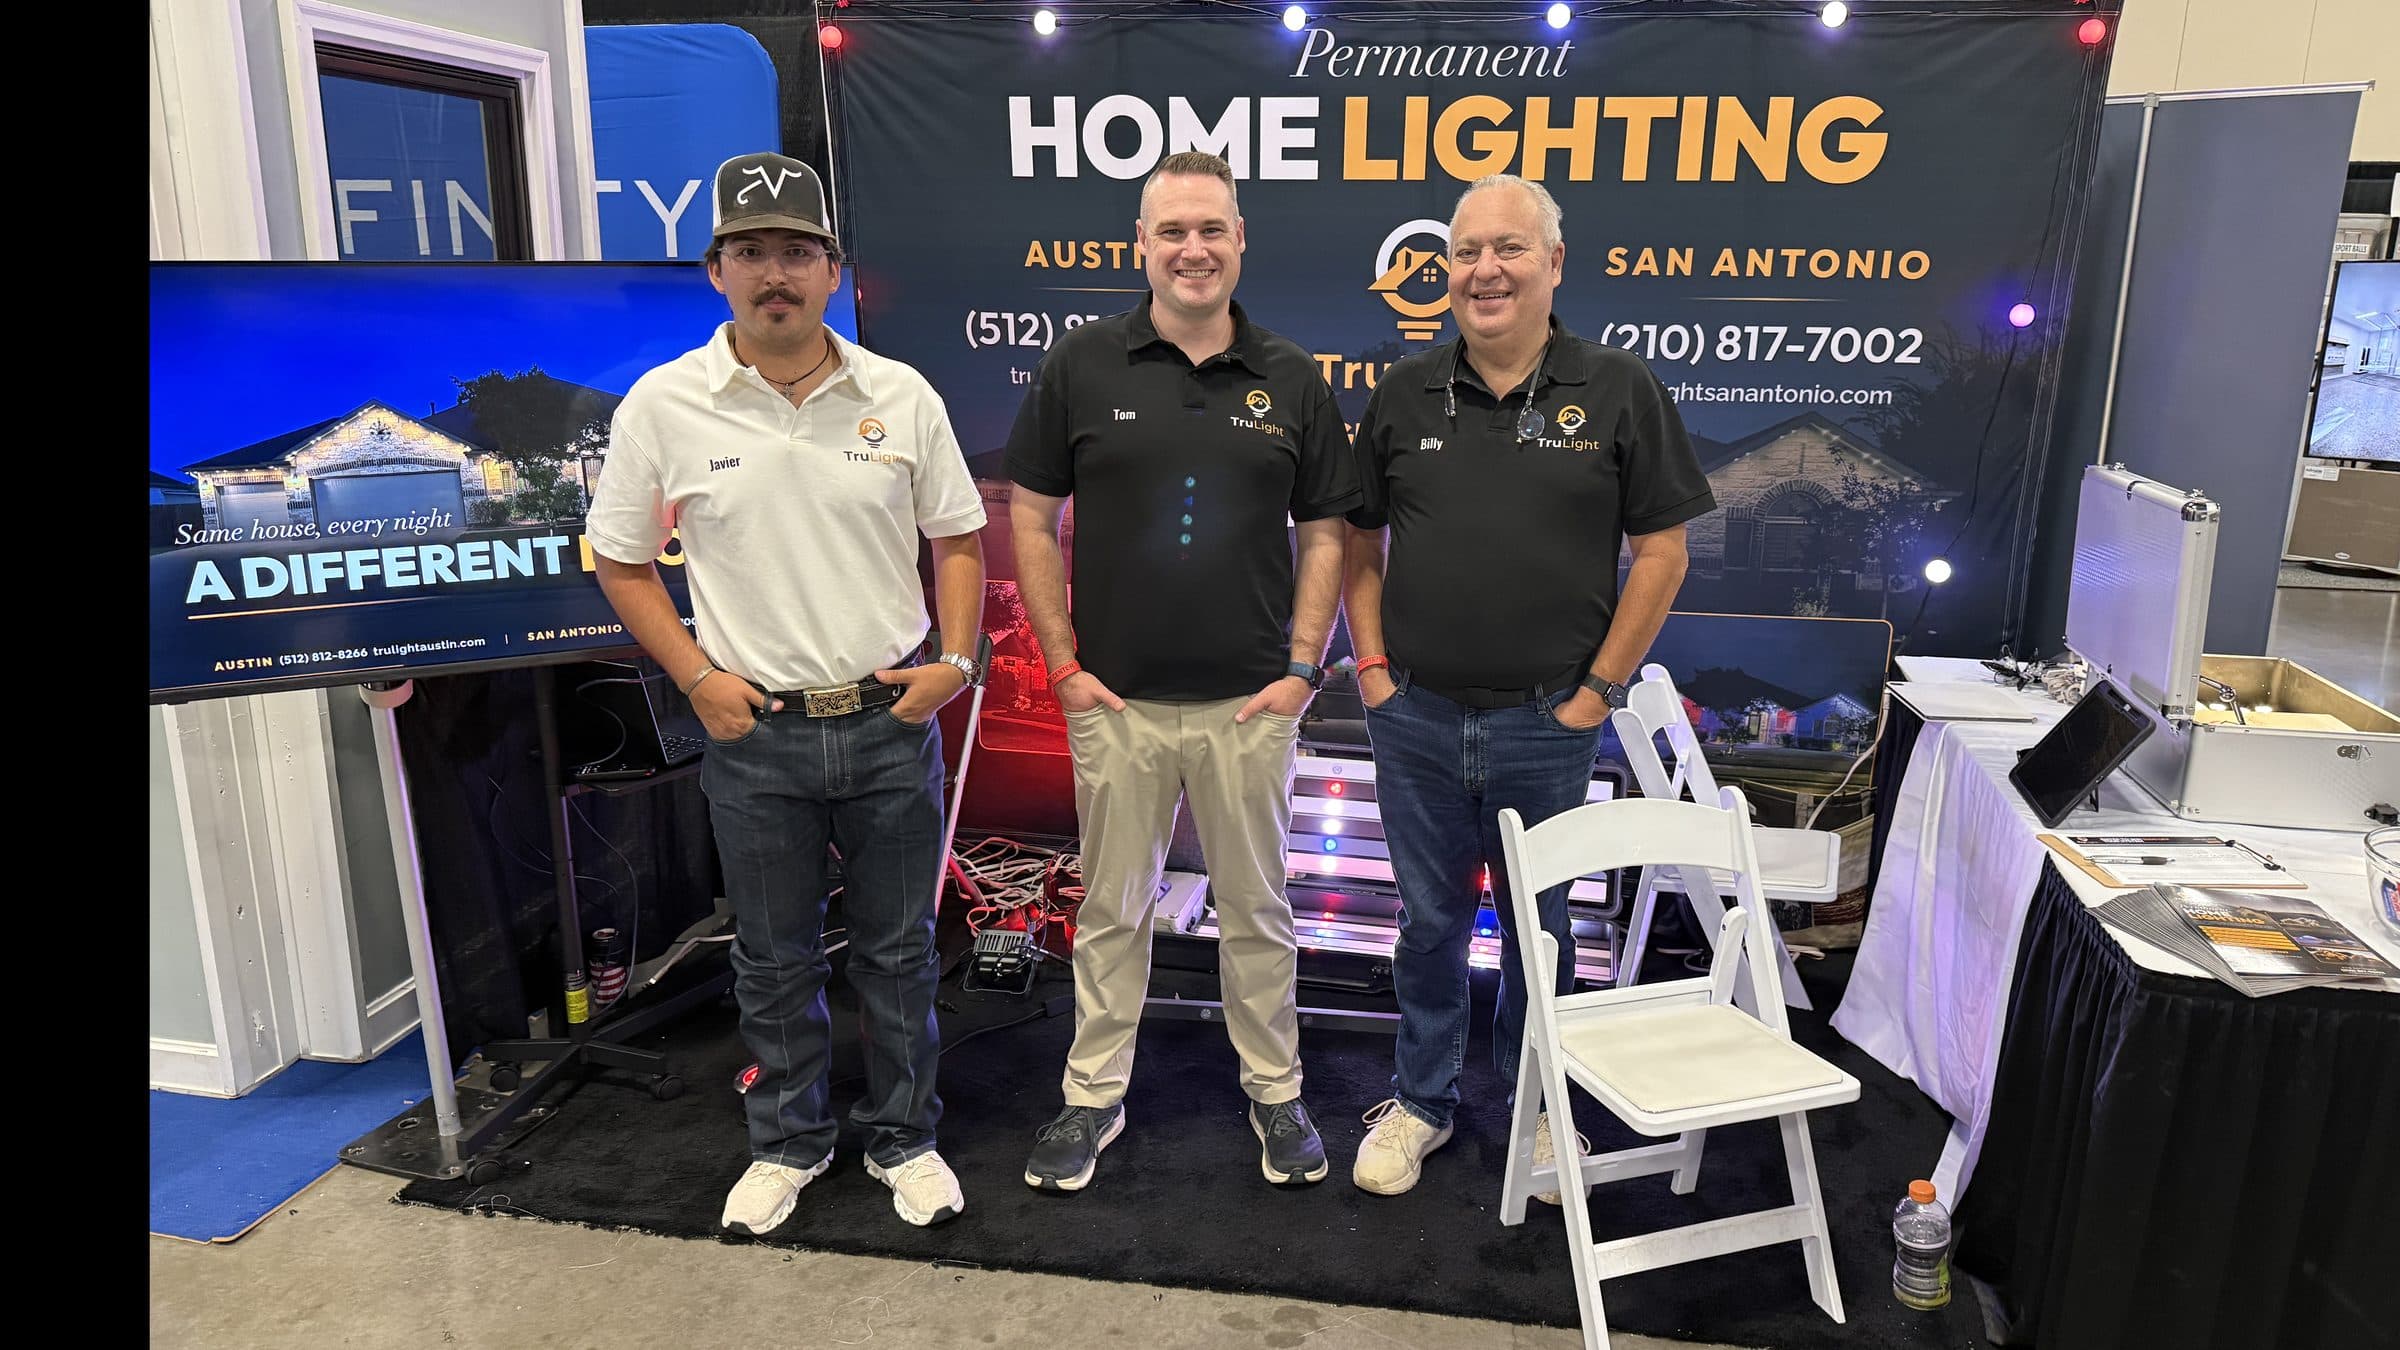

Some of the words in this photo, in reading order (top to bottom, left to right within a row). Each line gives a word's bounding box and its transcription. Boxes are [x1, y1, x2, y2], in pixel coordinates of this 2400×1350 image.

[1288, 27, 1575, 78] Permanent
[1008, 94, 1320, 180] HOME
[1343, 94, 1888, 184] LIGHTING
[1024, 240, 1143, 269] AUSTI
[1604, 247, 1694, 277] SAN
[1710, 248, 1931, 280] ANTONIO
[966, 309, 1054, 351] (512)
[1601, 322, 1705, 365] (210)
[1715, 325, 1924, 364] 817-7002
[1113, 409, 1136, 421] Tom
[1230, 416, 1285, 437] TruLight
[1420, 437, 1444, 451] Billy
[1537, 437, 1600, 451] TruLight
[709, 455, 742, 472] Javier
[174, 523, 244, 545] Same
[250, 518, 321, 540] house,
[327, 517, 389, 538] every
[393, 508, 452, 531] night
[186, 560, 236, 604] A
[240, 535, 570, 600] DIFFERENT
[527, 629, 555, 641] SAN
[559, 623, 623, 638] ANTONIO
[214, 656, 273, 672] AUSTIN
[279, 652, 309, 667] (512)
[312, 647, 369, 663] 812-8266
[373, 636, 486, 656] trulightaustin.com
